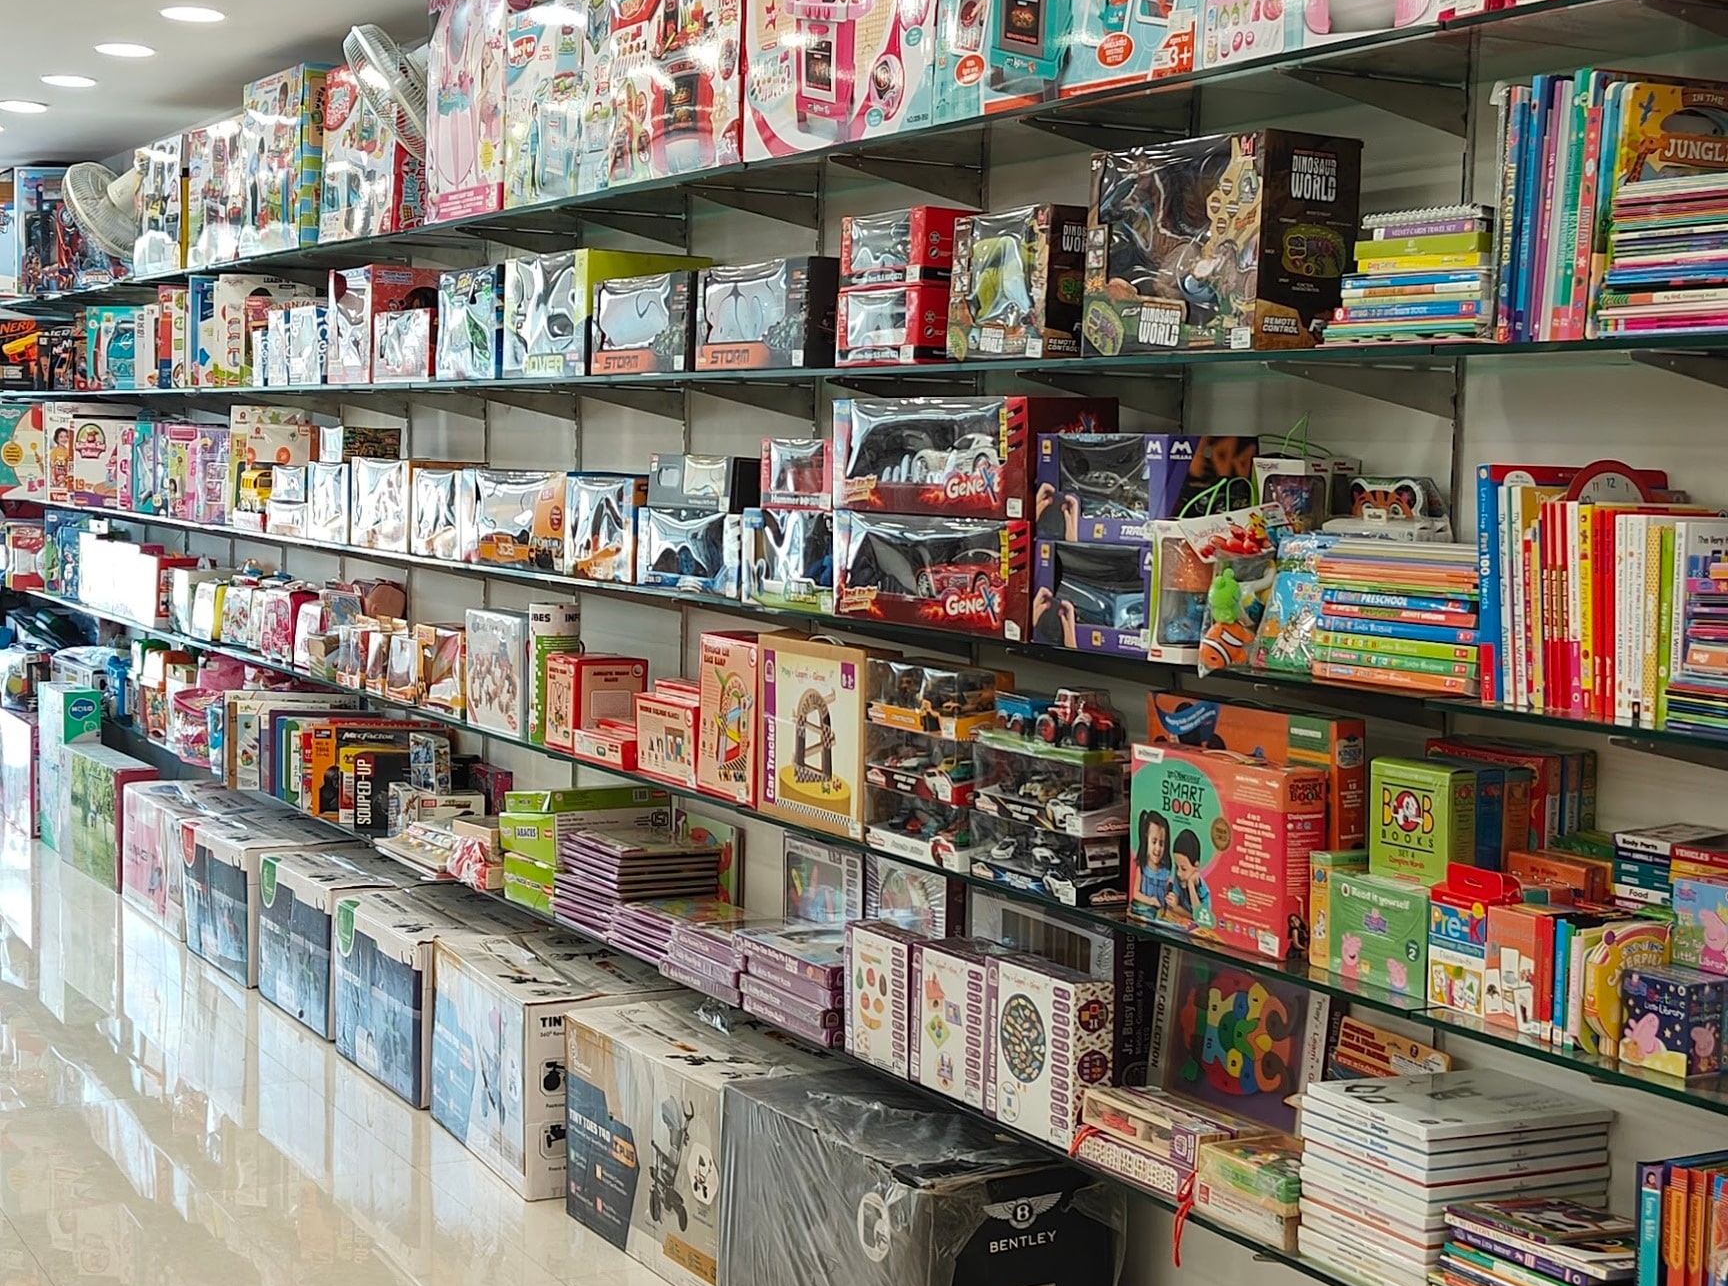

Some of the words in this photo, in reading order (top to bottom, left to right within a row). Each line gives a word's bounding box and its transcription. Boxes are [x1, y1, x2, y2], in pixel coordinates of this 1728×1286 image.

[1169, 45, 1192, 67] 3+
[1692, 94, 1703, 105] IN
[1706, 94, 1725, 106] THE
[1291, 154, 1337, 177] DINOSAUR
[1290, 173, 1337, 202] WORLD
[1566, 209, 1577, 265] TRANSPORT
[1140, 304, 1182, 325] DINOSAUR
[1263, 316, 1297, 326] REMOTE
[1138, 320, 1180, 347] WORLD
[1262, 323, 1299, 334] CONTROL
[1048, 338, 1076, 347] REMOTE
[604, 356, 638, 369] STORM
[709, 349, 750, 365] STORM
[1592, 482, 1599, 491] 11
[1606, 477, 1616, 489] 12
[1480, 532, 1489, 553] First
[1698, 535, 1709, 545] The
[1480, 554, 1491, 576] 100
[1361, 592, 1408, 606] PRESCHOOL
[1481, 578, 1490, 610] Words
[1581, 582, 1589, 606] First
[1515, 614, 1523, 639] First
[1581, 609, 1590, 643] Words
[1673, 611, 1681, 636] FIRST
[1501, 626, 1511, 678] Animals
[1671, 637, 1680, 673] WINTER
[1516, 642, 1525, 685] Words
[765, 717, 776, 771] Tracker
[356, 758, 373, 826] SOUPED-UP
[765, 773, 775, 799] Car
[1161, 780, 1206, 801] SMART
[1288, 782, 1324, 795] SMART
[1289, 791, 1324, 803] BOOK
[1161, 797, 1203, 820] BOOK
[1382, 787, 1434, 835] BOB
[516, 828, 537, 838] ABACUS
[1381, 830, 1434, 849] BOOKS
[1622, 837, 1639, 848] Body
[1639, 841, 1658, 851] Parts
[1398, 849, 1409, 858] SET
[1675, 847, 1710, 862] VEHICLES
[1350, 887, 1371, 901] Read
[1378, 893, 1410, 911] yourself
[1629, 888, 1649, 900] Food
[1431, 904, 1485, 945] Pre-K
[1408, 948, 1417, 961] 2
[1672, 950, 1696, 963] Little
[1699, 953, 1728, 975] Library
[1161, 947, 1172, 993] PUZZLE
[1123, 971, 1135, 1003] Bead
[1123, 1006, 1136, 1035] Busy
[1658, 1003, 1686, 1020] Library
[1151, 995, 1168, 1068] COLLECTION
[1122, 1039, 1134, 1055] Jr.
[1016, 1203, 1030, 1222] B
[989, 1230, 1057, 1254] BENTLEY
